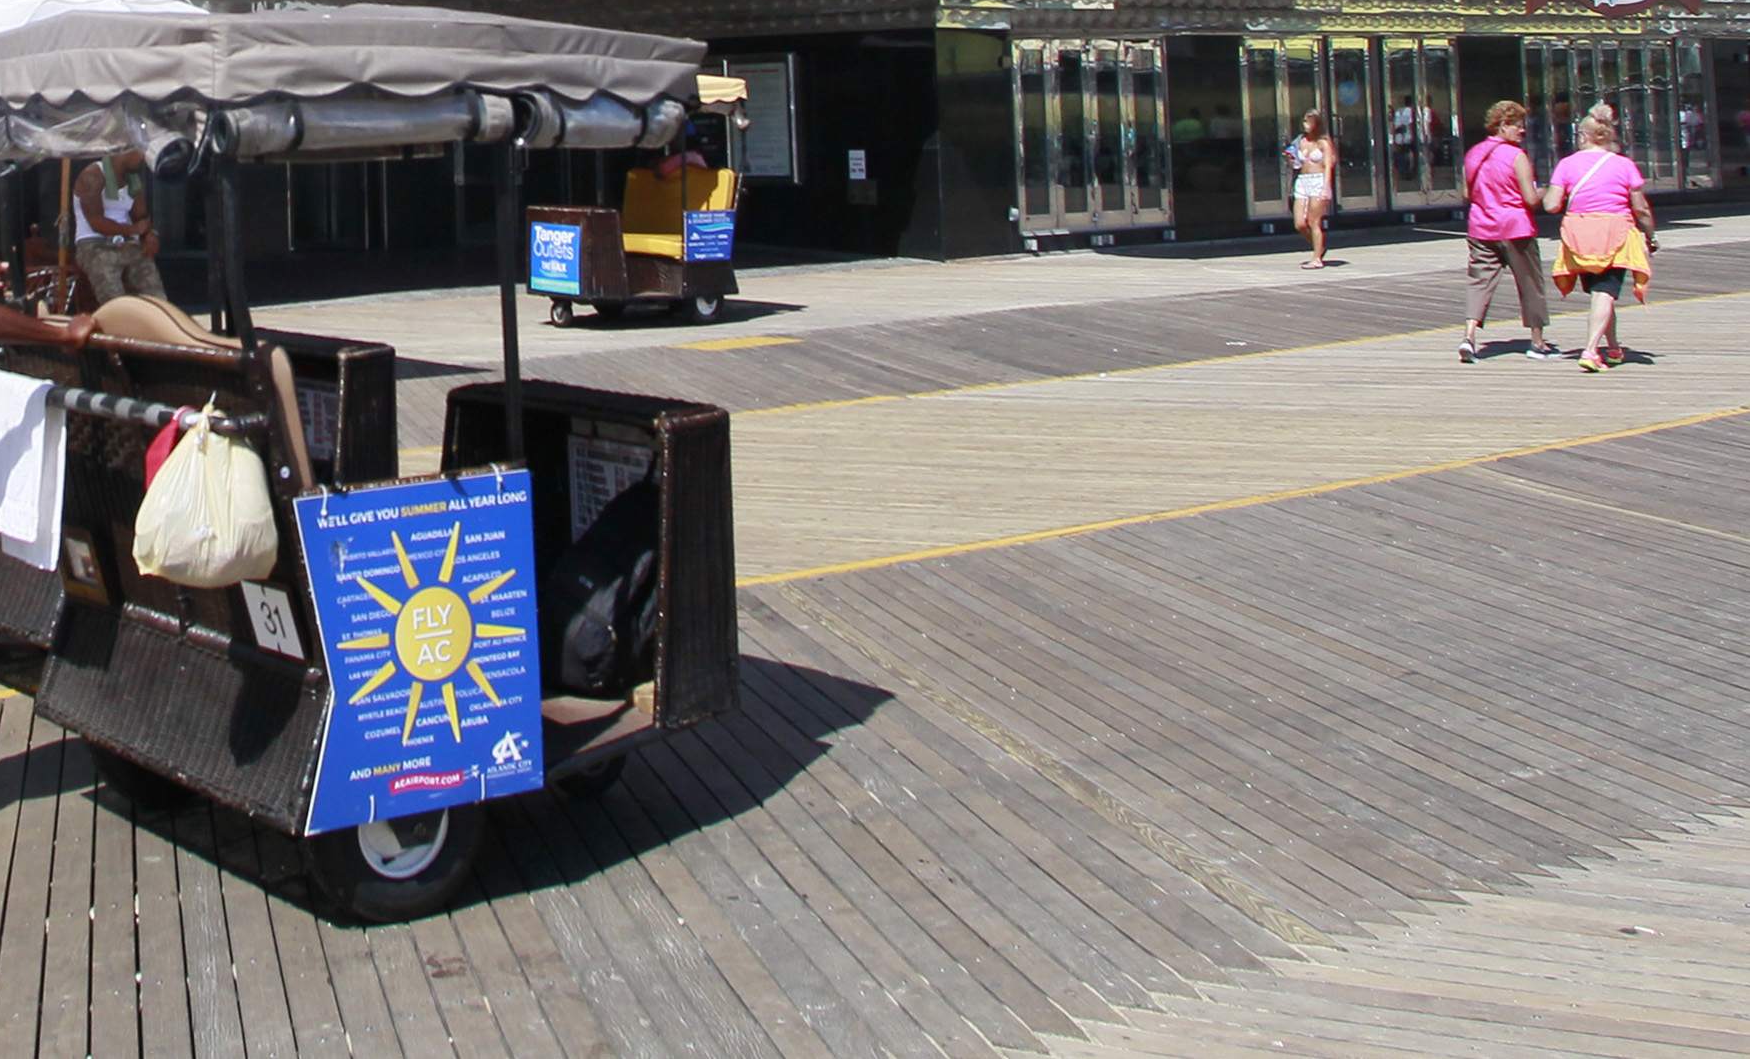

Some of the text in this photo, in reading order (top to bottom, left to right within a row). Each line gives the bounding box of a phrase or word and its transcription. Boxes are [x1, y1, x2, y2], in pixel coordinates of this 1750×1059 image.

[534, 225, 575, 245] Tanger
[533, 240, 575, 260] Outlets
[349, 511, 376, 524] GIVE
[376, 507, 399, 521] YOU
[400, 501, 448, 518] SUMMER
[448, 498, 468, 512] ALL
[468, 494, 496, 508] YEAR
[497, 490, 528, 505] LONG
[464, 530, 506, 544] SAN JUAN
[433, 548, 446, 558] CIT
[456, 550, 501, 564] OS ANGELES
[363, 565, 401, 578] DOMINGO
[462, 569, 503, 584] ACAPULCO
[491, 589, 528, 602] MAARTEN
[351, 614, 368, 623] SAN
[412, 604, 452, 630] FLY
[490, 607, 516, 618] BELIZE
[260, 601, 286, 639] 31
[473, 639, 491, 649] PORT
[502, 635, 527, 644] PRINCE
[344, 650, 392, 665] PANAMA CITY
[417, 640, 452, 665] AC
[507, 650, 520, 659] BAY
[348, 669, 379, 681] LAS VEGA
[484, 666, 526, 679] ENSACOLA
[469, 695, 523, 712] OKLAHA CITY
[357, 710, 384, 722] MYRTLE
[415, 713, 450, 728] CANCUN
[460, 715, 489, 728] ARUBA
[364, 726, 401, 740] COZUMEL
[406, 734, 435, 747] HOENIX
[349, 755, 432, 782] AND MANY MORE
[486, 762, 518, 774] ATLANTIC
[518, 759, 533, 769] CITY
